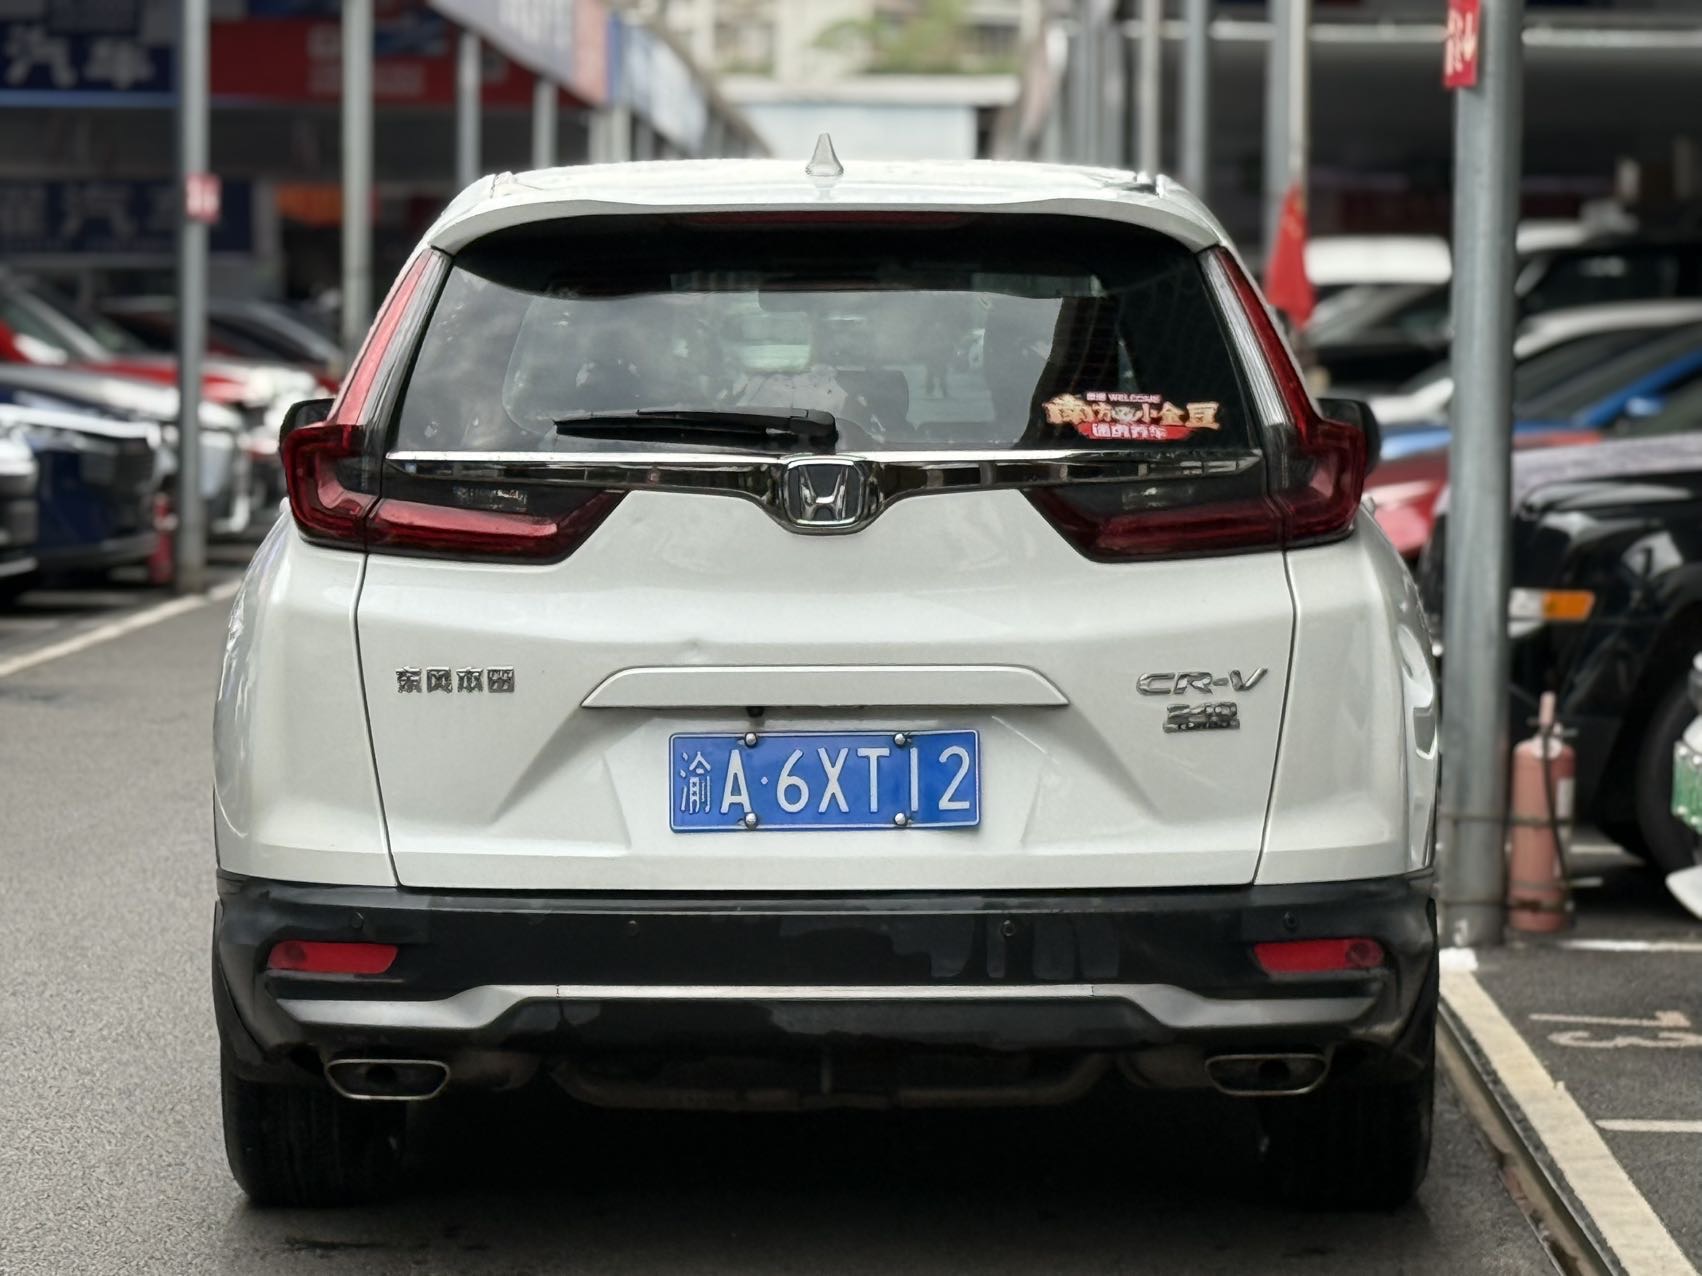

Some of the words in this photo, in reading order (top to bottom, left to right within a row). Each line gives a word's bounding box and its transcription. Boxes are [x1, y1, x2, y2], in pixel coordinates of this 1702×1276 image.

[395, 666, 516, 694] 东风本田
[1136, 667, 1269, 696] CR-V
[679, 746, 971, 814] 渝A·6XT12
